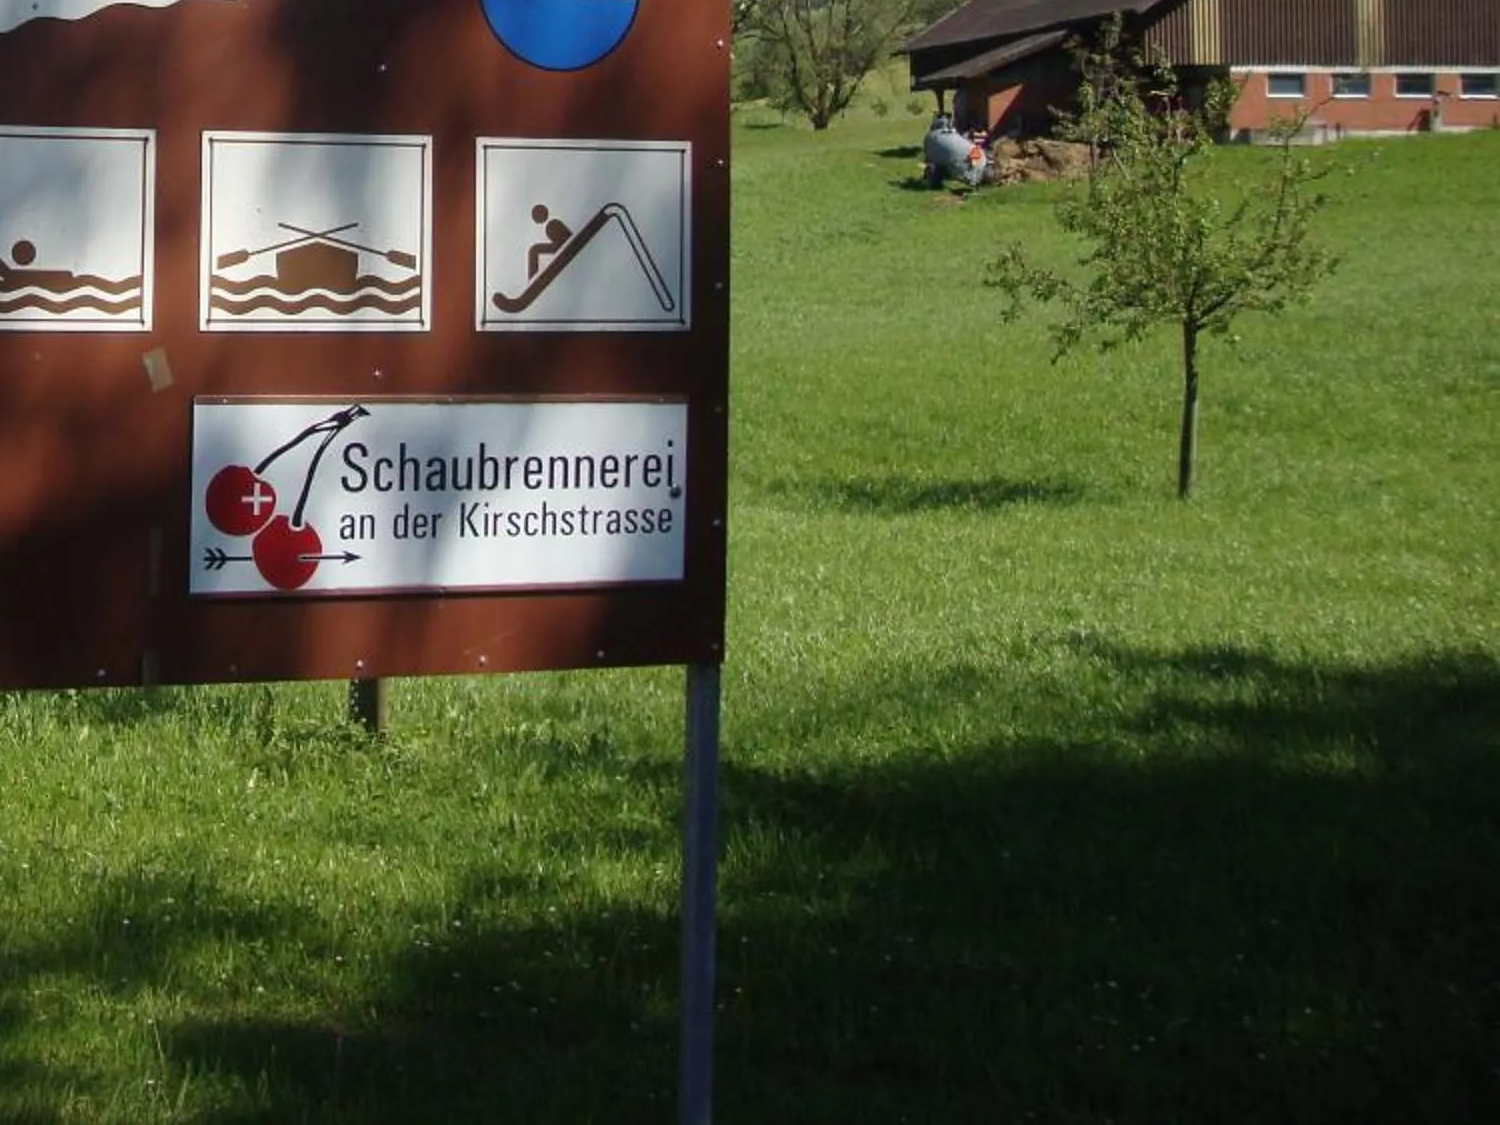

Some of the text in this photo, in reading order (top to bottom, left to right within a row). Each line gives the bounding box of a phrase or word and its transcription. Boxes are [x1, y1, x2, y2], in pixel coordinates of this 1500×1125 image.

[341, 441, 675, 493] Schaubrennerei
[340, 499, 673, 540] an der Kirschstrasse
